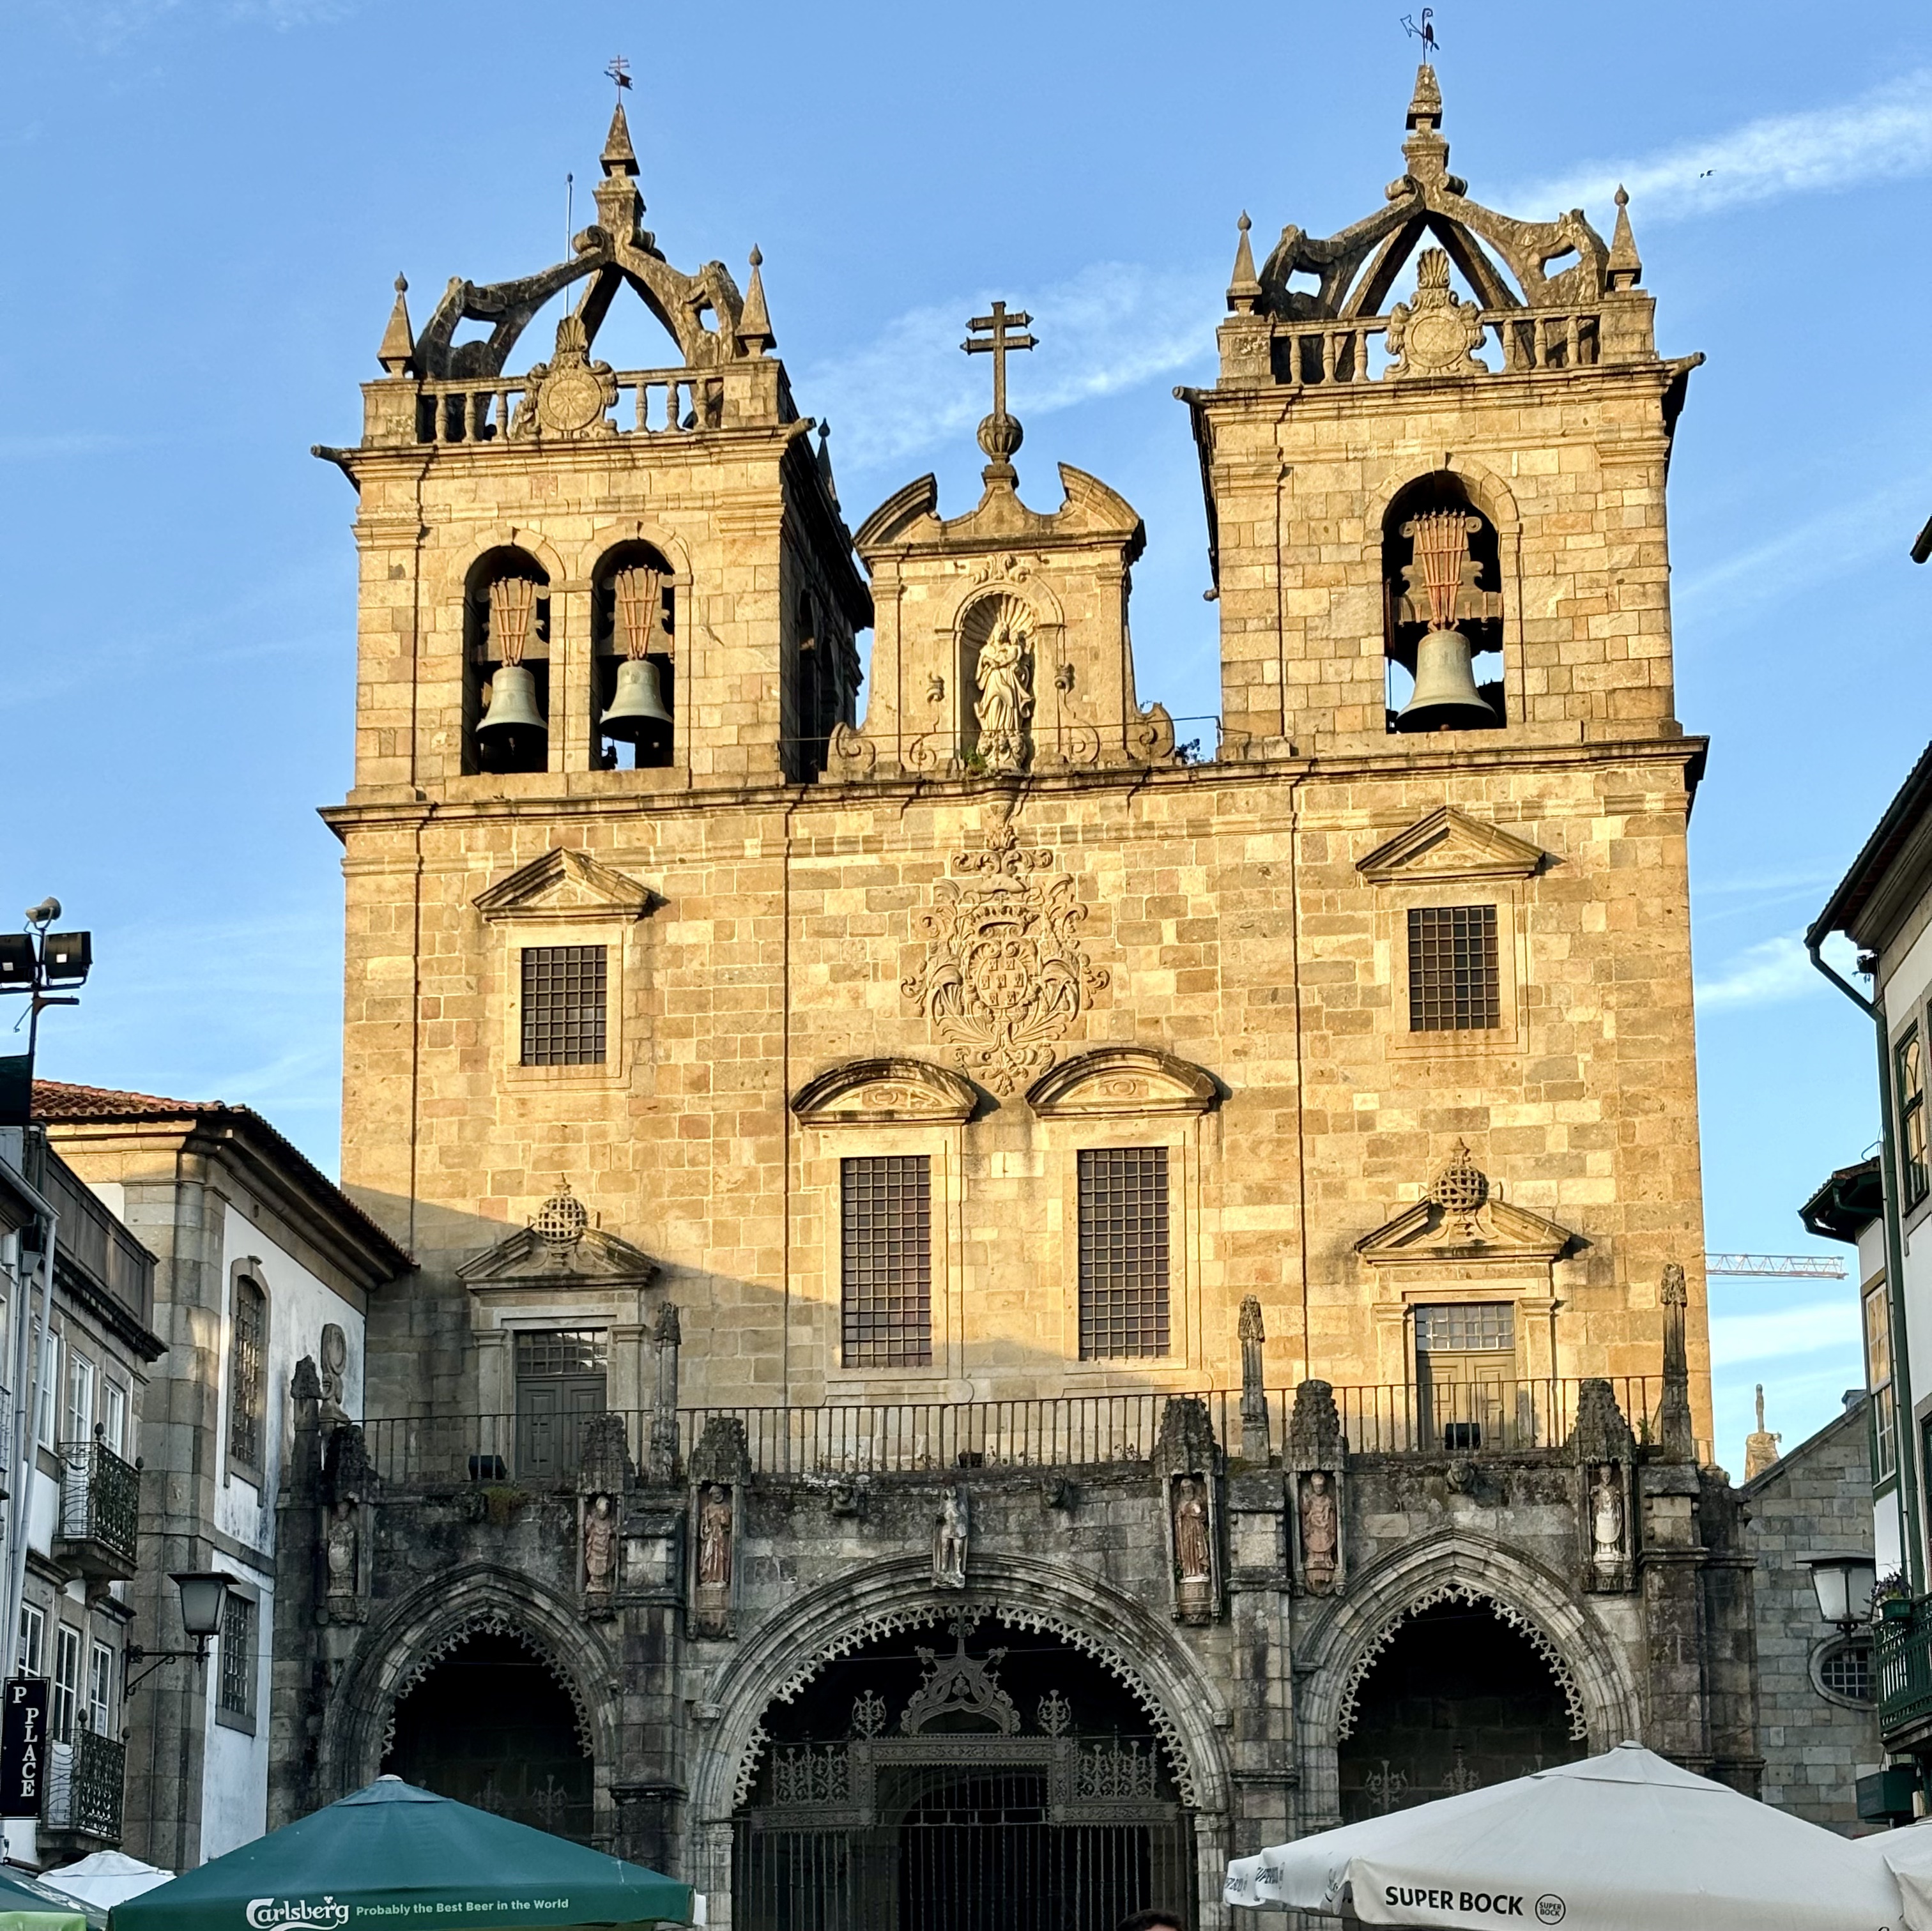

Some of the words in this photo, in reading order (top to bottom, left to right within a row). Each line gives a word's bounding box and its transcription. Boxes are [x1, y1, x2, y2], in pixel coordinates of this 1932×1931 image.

[20, 1707, 39, 1797] PLACE
[246, 1897, 349, 1930] Carlsberg
[356, 1904, 411, 1916] Probably
[413, 1903, 433, 1913] the
[436, 1902, 463, 1912] Best
[466, 1901, 494, 1911] Beer
[497, 1900, 509, 1910] in
[511, 1899, 531, 1909] the
[533, 1899, 569, 1909] World
[1385, 1886, 1453, 1910] SUPER
[1460, 1892, 1524, 1916] BOCK
[1539, 1902, 1561, 1910] SUPER
